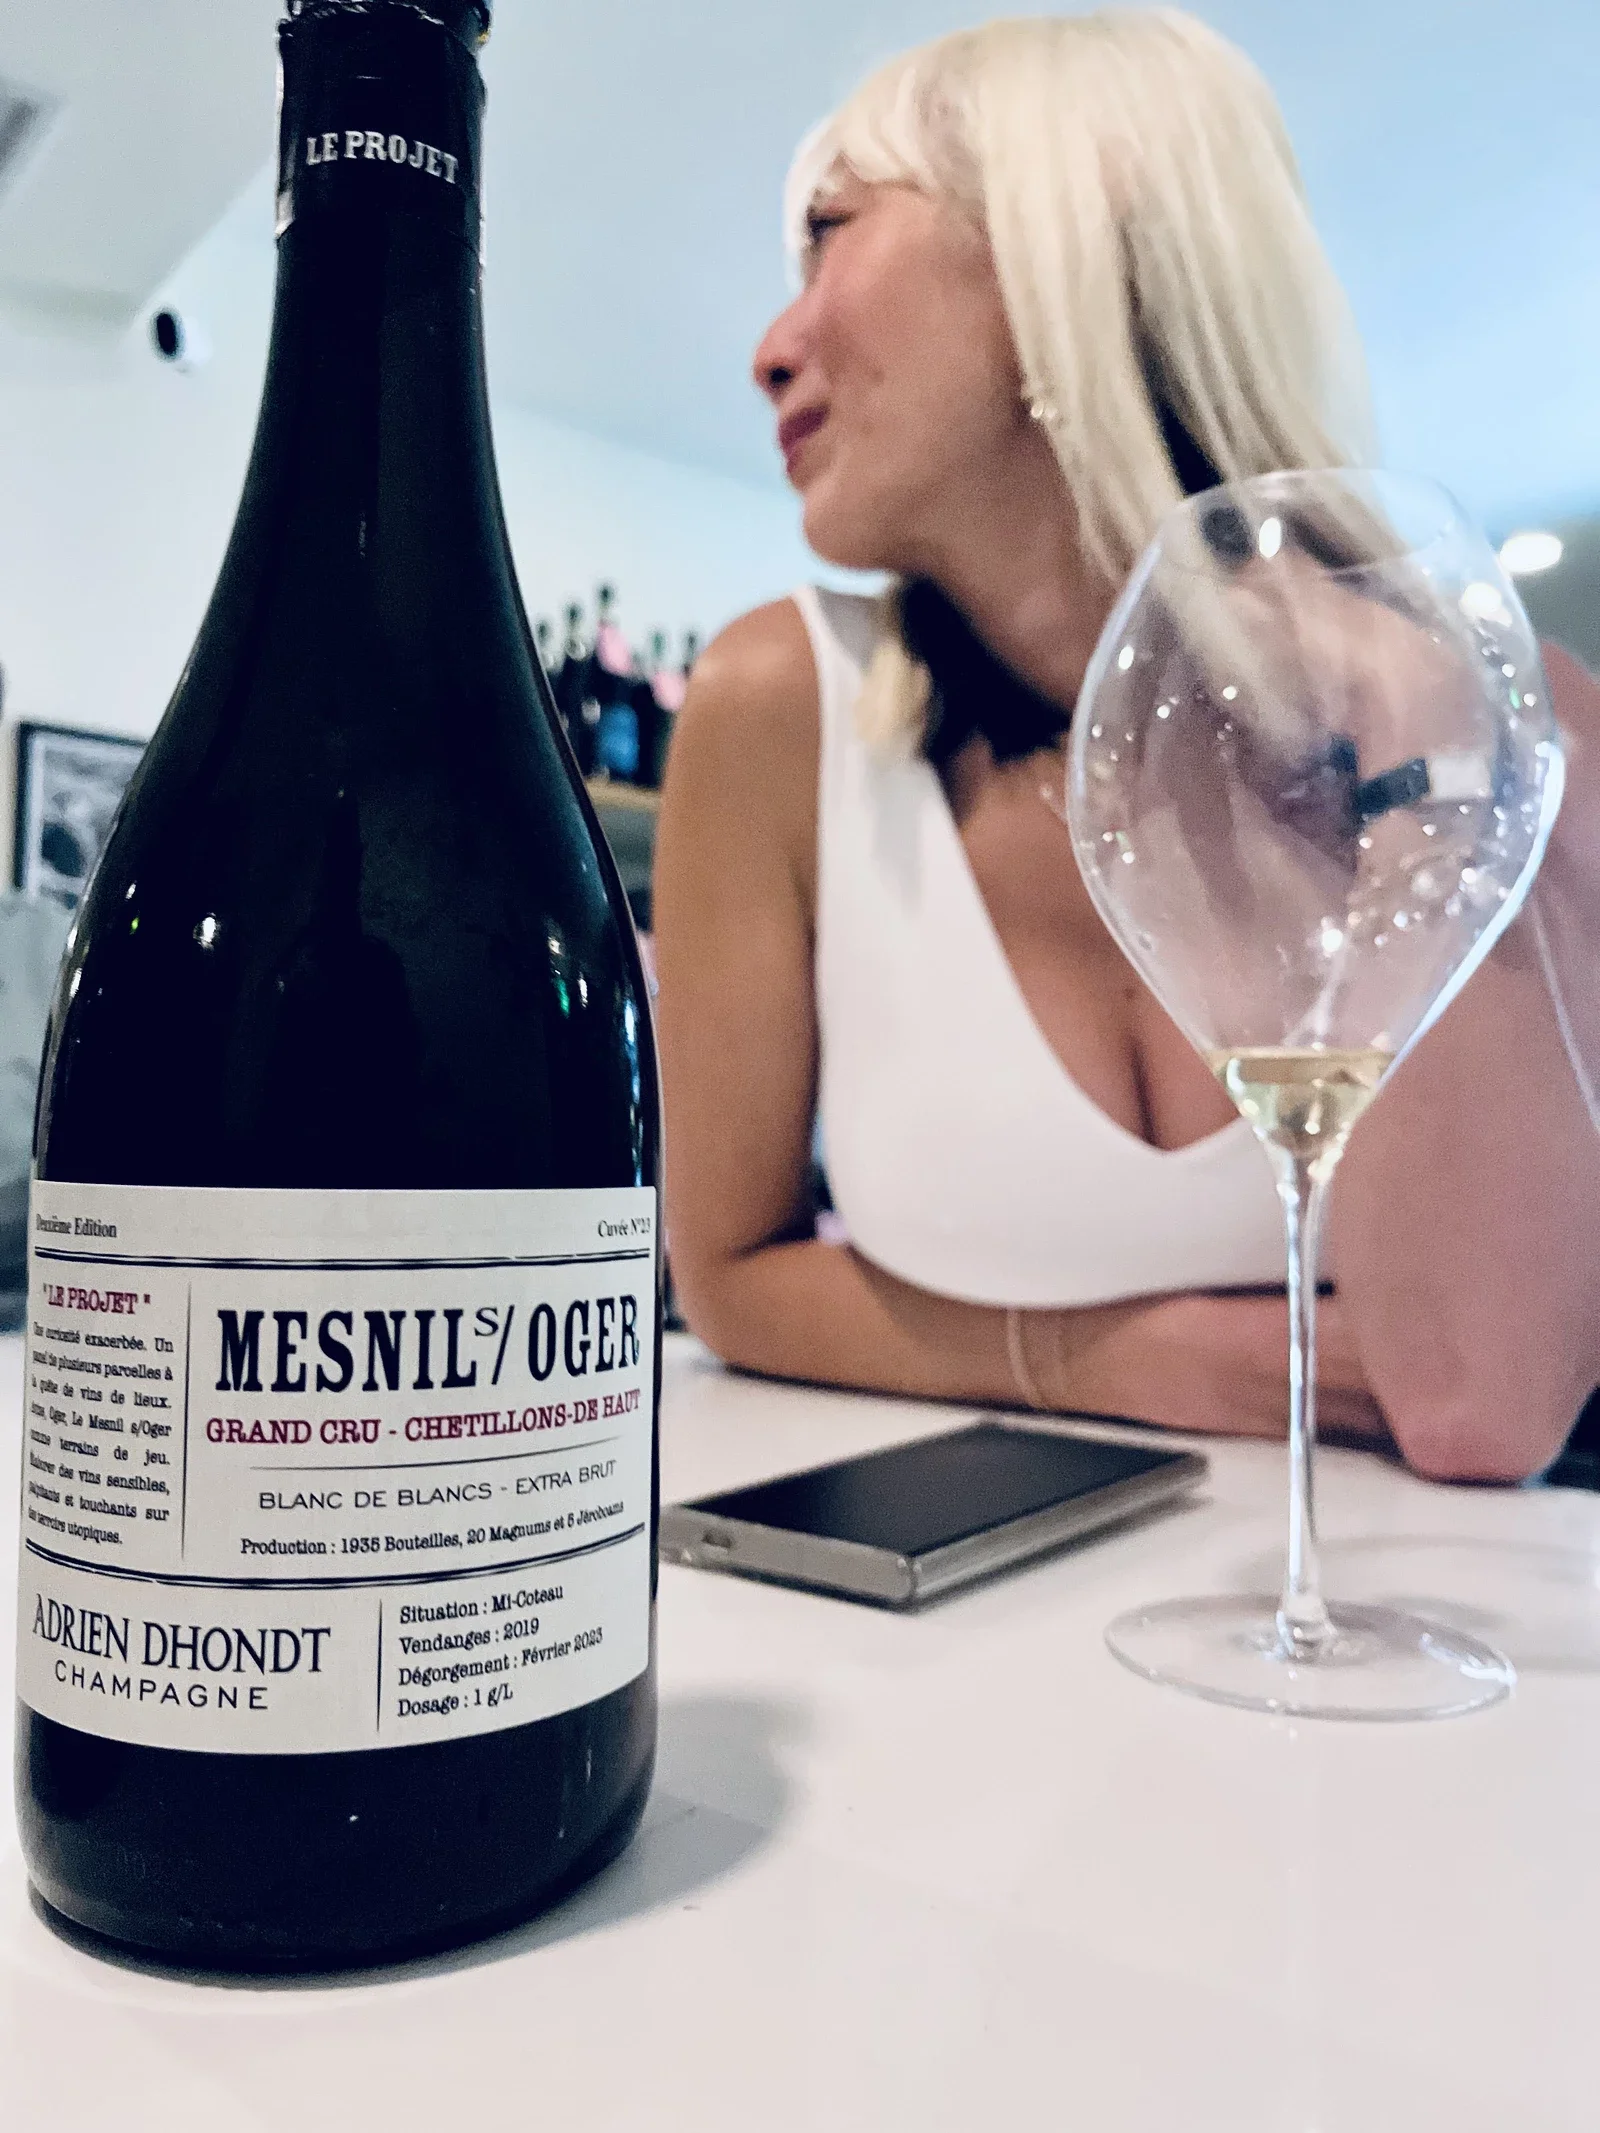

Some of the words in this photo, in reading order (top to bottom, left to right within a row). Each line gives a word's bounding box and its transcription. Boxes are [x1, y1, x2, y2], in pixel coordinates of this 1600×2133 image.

[306, 133, 339, 165] LE
[344, 131, 459, 184] PROJET
[74, 1217, 118, 1238] Edition
[598, 1218, 628, 1237] Cuvée
[68, 1287, 138, 1314] PROJET
[85, 1334, 147, 1351] exacerbée.
[155, 1337, 174, 1352] Un
[527, 1294, 640, 1382] OGER
[58, 1355, 102, 1373] plusieurs
[104, 1364, 161, 1380] parcelles
[165, 1366, 173, 1381] à
[63, 1383, 74, 1397] de
[80, 1387, 102, 1401] vins
[111, 1390, 125, 1405] de
[134, 1392, 172, 1409] lieux.
[72, 1411, 83, 1426] Le
[89, 1414, 124, 1432] Mesnil
[131, 1420, 172, 1439] s/Oger
[206, 1418, 311, 1445] GRAND
[320, 1419, 381, 1444] CRU
[604, 1389, 641, 1417] HAUT
[60, 1438, 99, 1456] terrains
[114, 1445, 128, 1461] de
[144, 1449, 170, 1466] jeu.
[59, 1463, 73, 1479] des
[79, 1469, 101, 1484] vins
[106, 1475, 170, 1496] sensibles,
[259, 1492, 342, 1510] BLANC
[354, 1491, 386, 1509] DE
[398, 1483, 492, 1506] BLANCS
[516, 1471, 572, 1496] EXTRA
[579, 1460, 617, 1483] BRUT
[65, 1496, 73, 1507] et
[80, 1496, 137, 1518] touchants
[145, 1508, 170, 1521] sur
[68, 1524, 123, 1544] utopiques.
[341, 1537, 380, 1554] 1935
[385, 1533, 462, 1553] Bouteilles,
[467, 1528, 486, 1545] 20
[490, 1521, 551, 1543] Magnums
[554, 1517, 565, 1531] et
[491, 1585, 564, 1613] Mi-Coteau
[33, 1594, 129, 1660] ADRIEN
[142, 1623, 331, 1674] DHONDT
[504, 1617, 539, 1640] 2019
[521, 1641, 572, 1666] Février
[574, 1627, 603, 1652] 2023
[55, 1661, 268, 1709] CHAMPAGNE
[474, 1689, 481, 1705] 1
[487, 1683, 513, 1707] g/L
